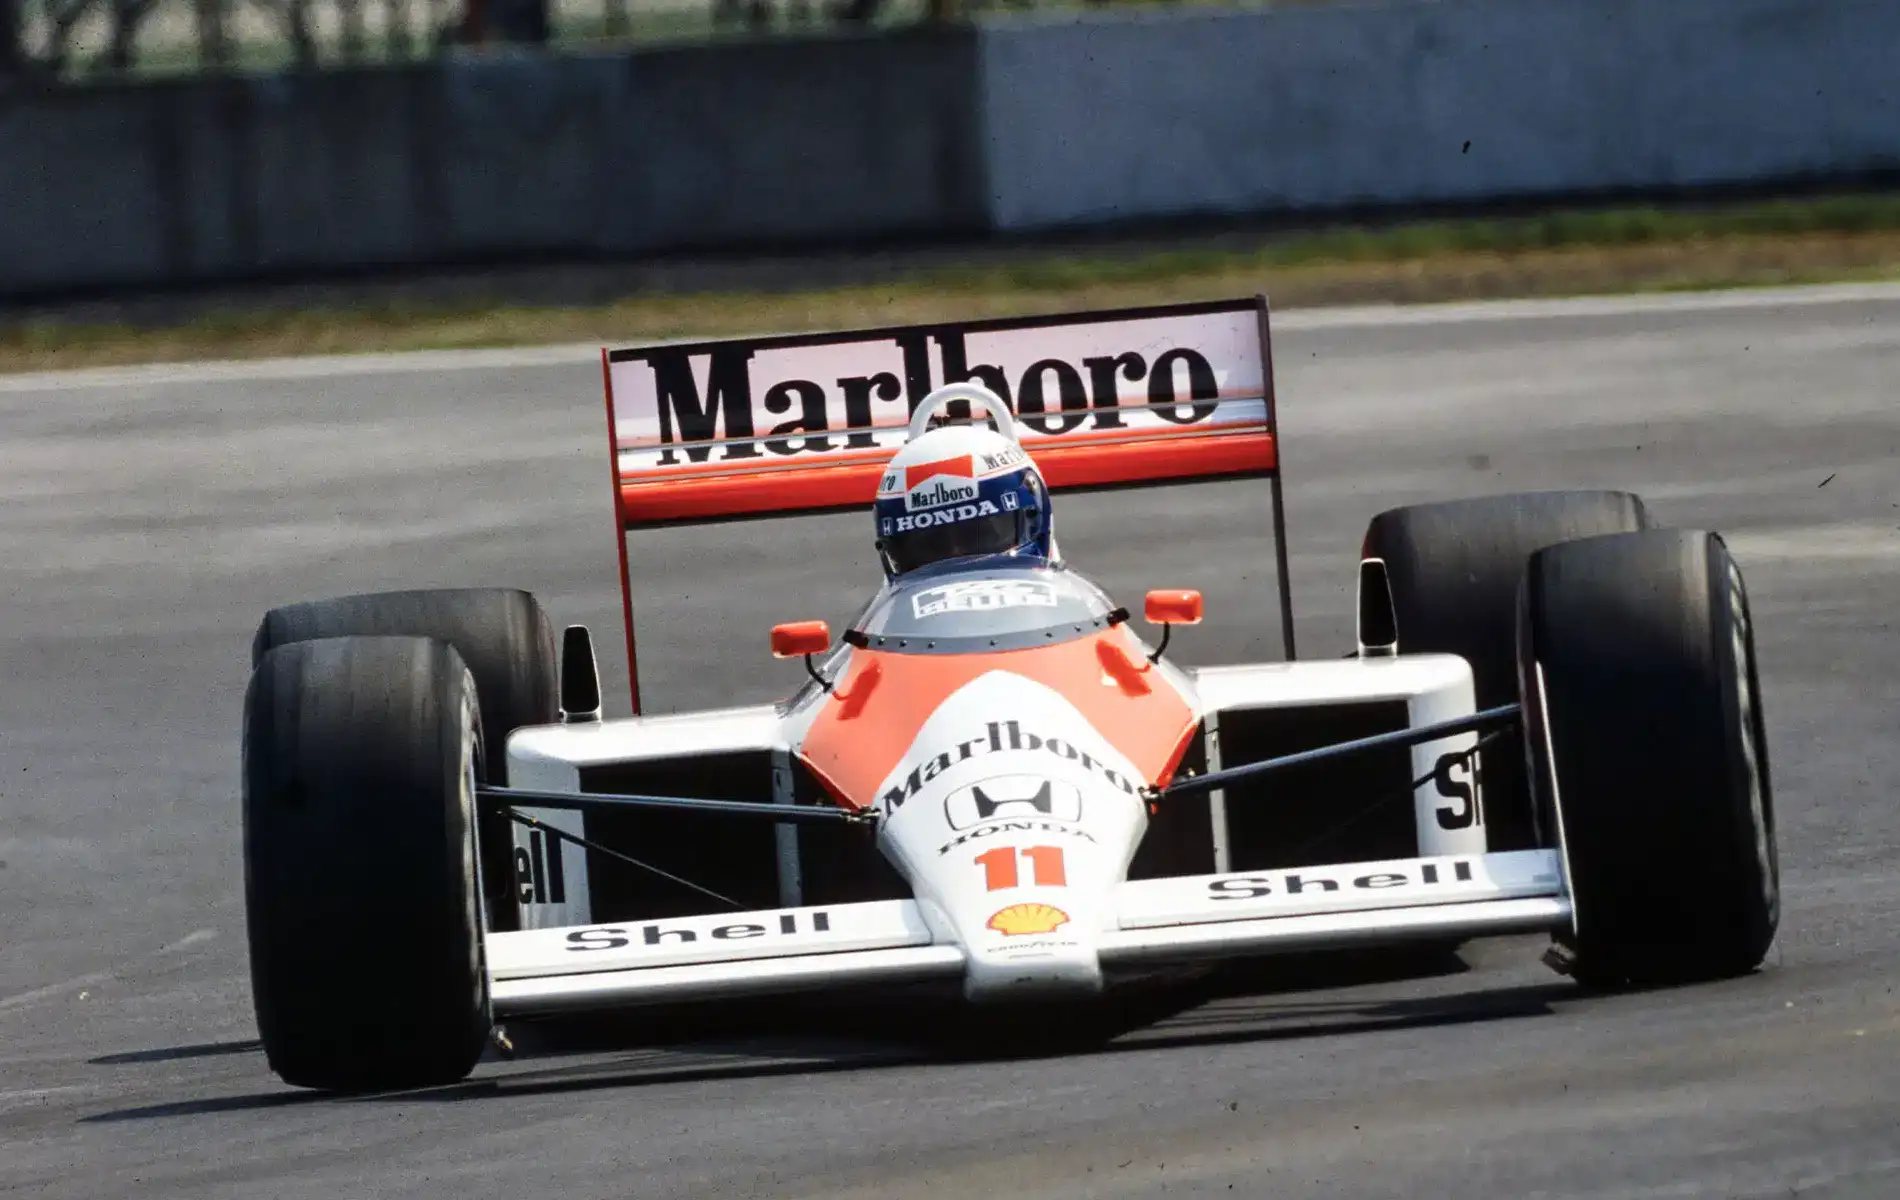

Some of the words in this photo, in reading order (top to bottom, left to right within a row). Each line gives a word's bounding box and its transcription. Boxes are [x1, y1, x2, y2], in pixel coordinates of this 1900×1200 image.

[648, 330, 1219, 466] Marlboro
[911, 482, 974, 509] Marlboro
[896, 500, 999, 532] HONDA
[883, 720, 1134, 816] Marlboro
[937, 821, 1099, 857] HONDA
[515, 830, 566, 905] ell
[974, 845, 1068, 892] 11
[1207, 861, 1472, 901] Shell
[565, 912, 830, 952] Shell
